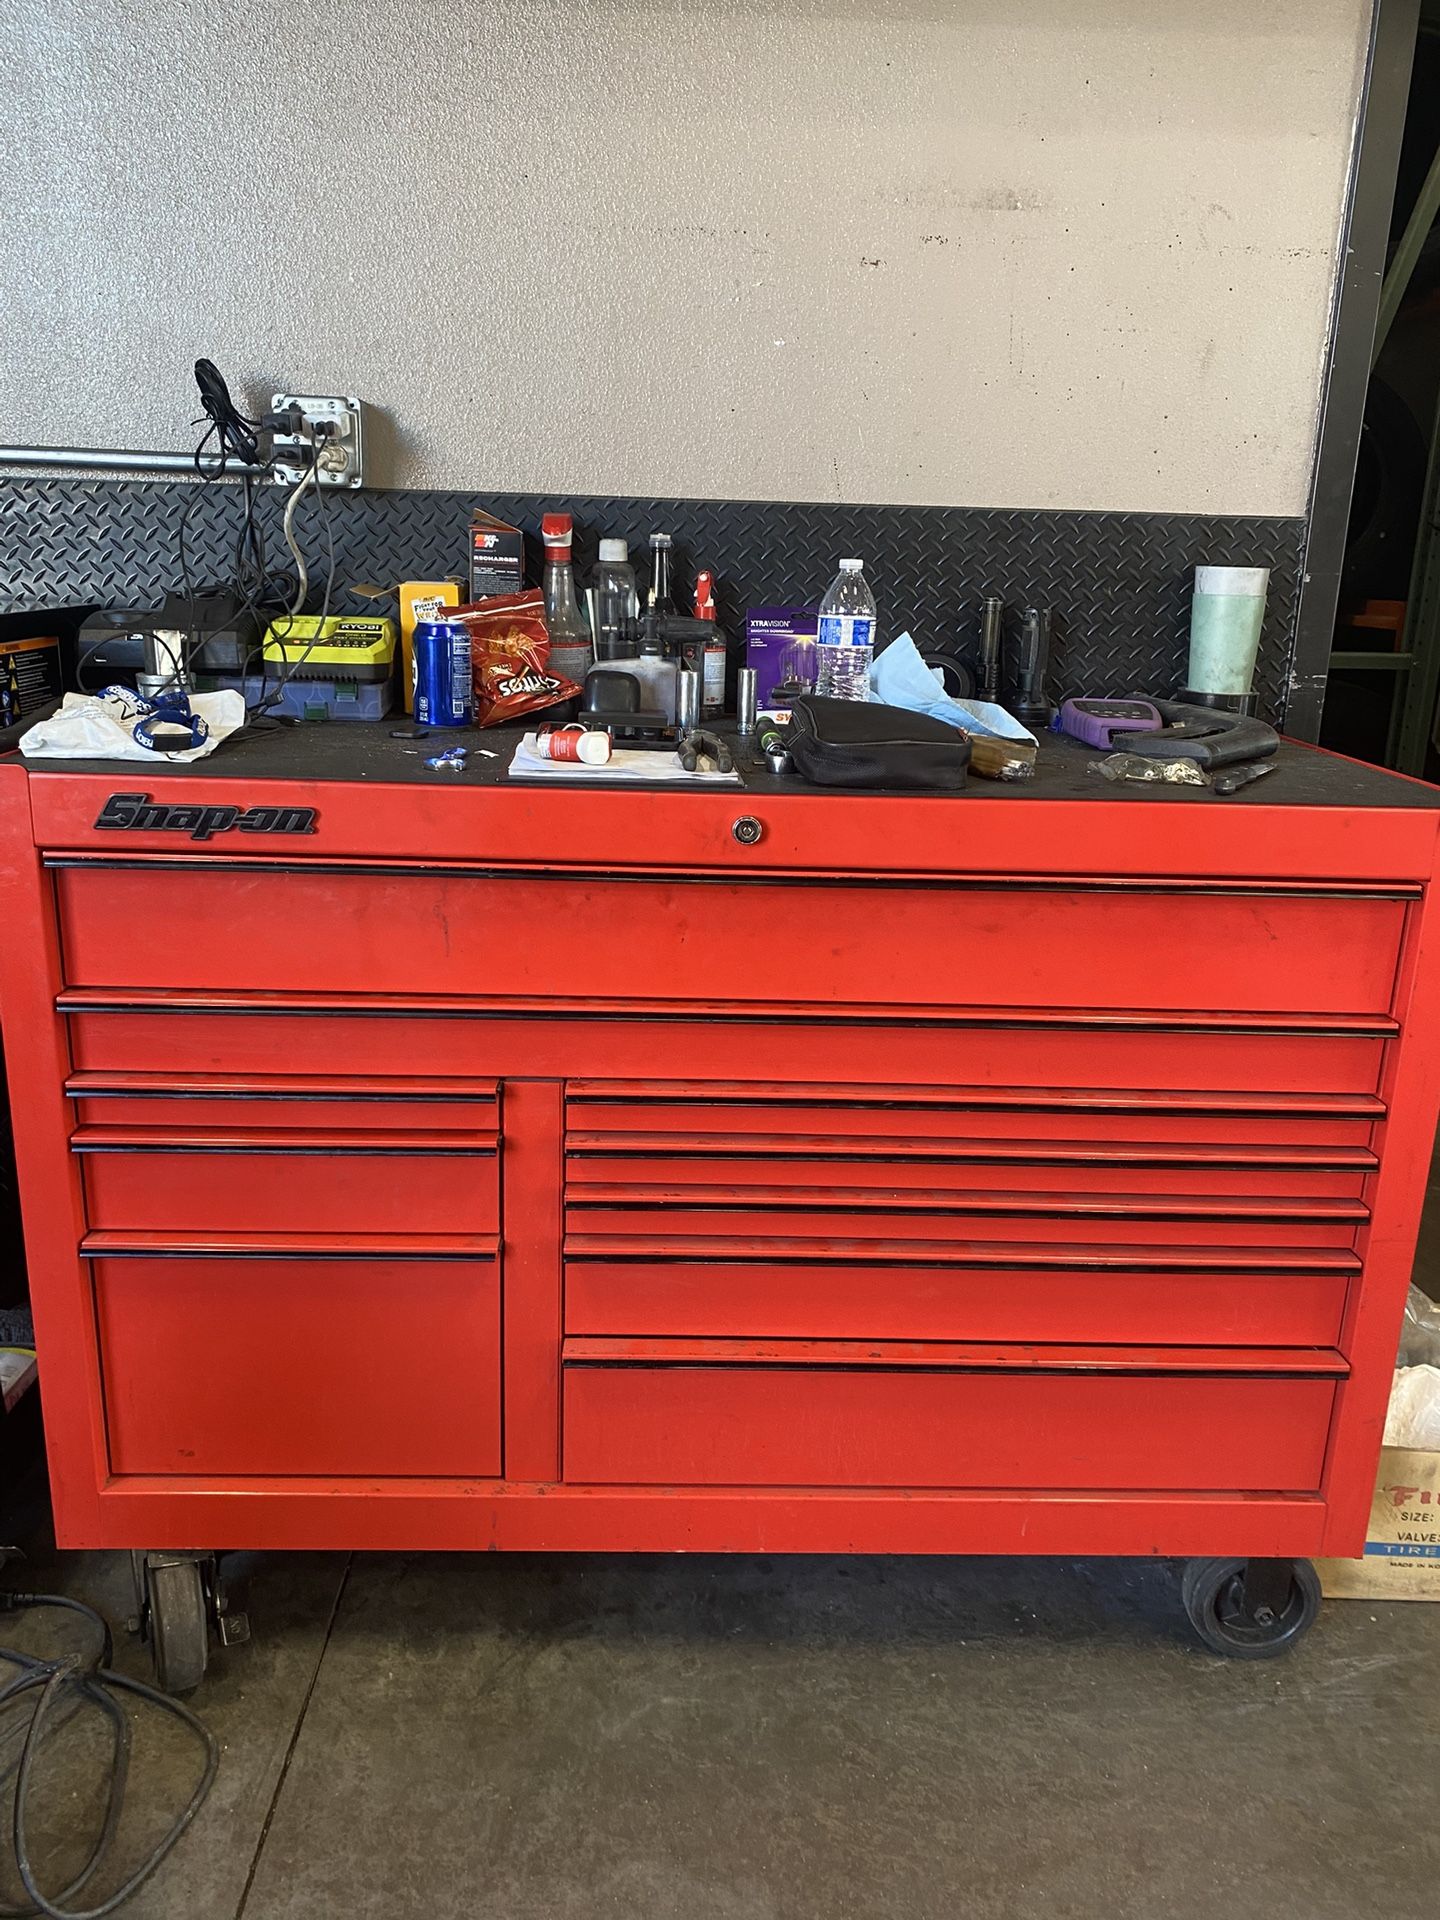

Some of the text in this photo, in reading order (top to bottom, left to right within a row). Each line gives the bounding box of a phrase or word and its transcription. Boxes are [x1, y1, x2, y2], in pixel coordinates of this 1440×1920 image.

[93, 793, 317, 840] Snap-on
[1401, 1511, 1434, 1522] SIZE:
[1384, 1545, 1437, 1555] TIRE
